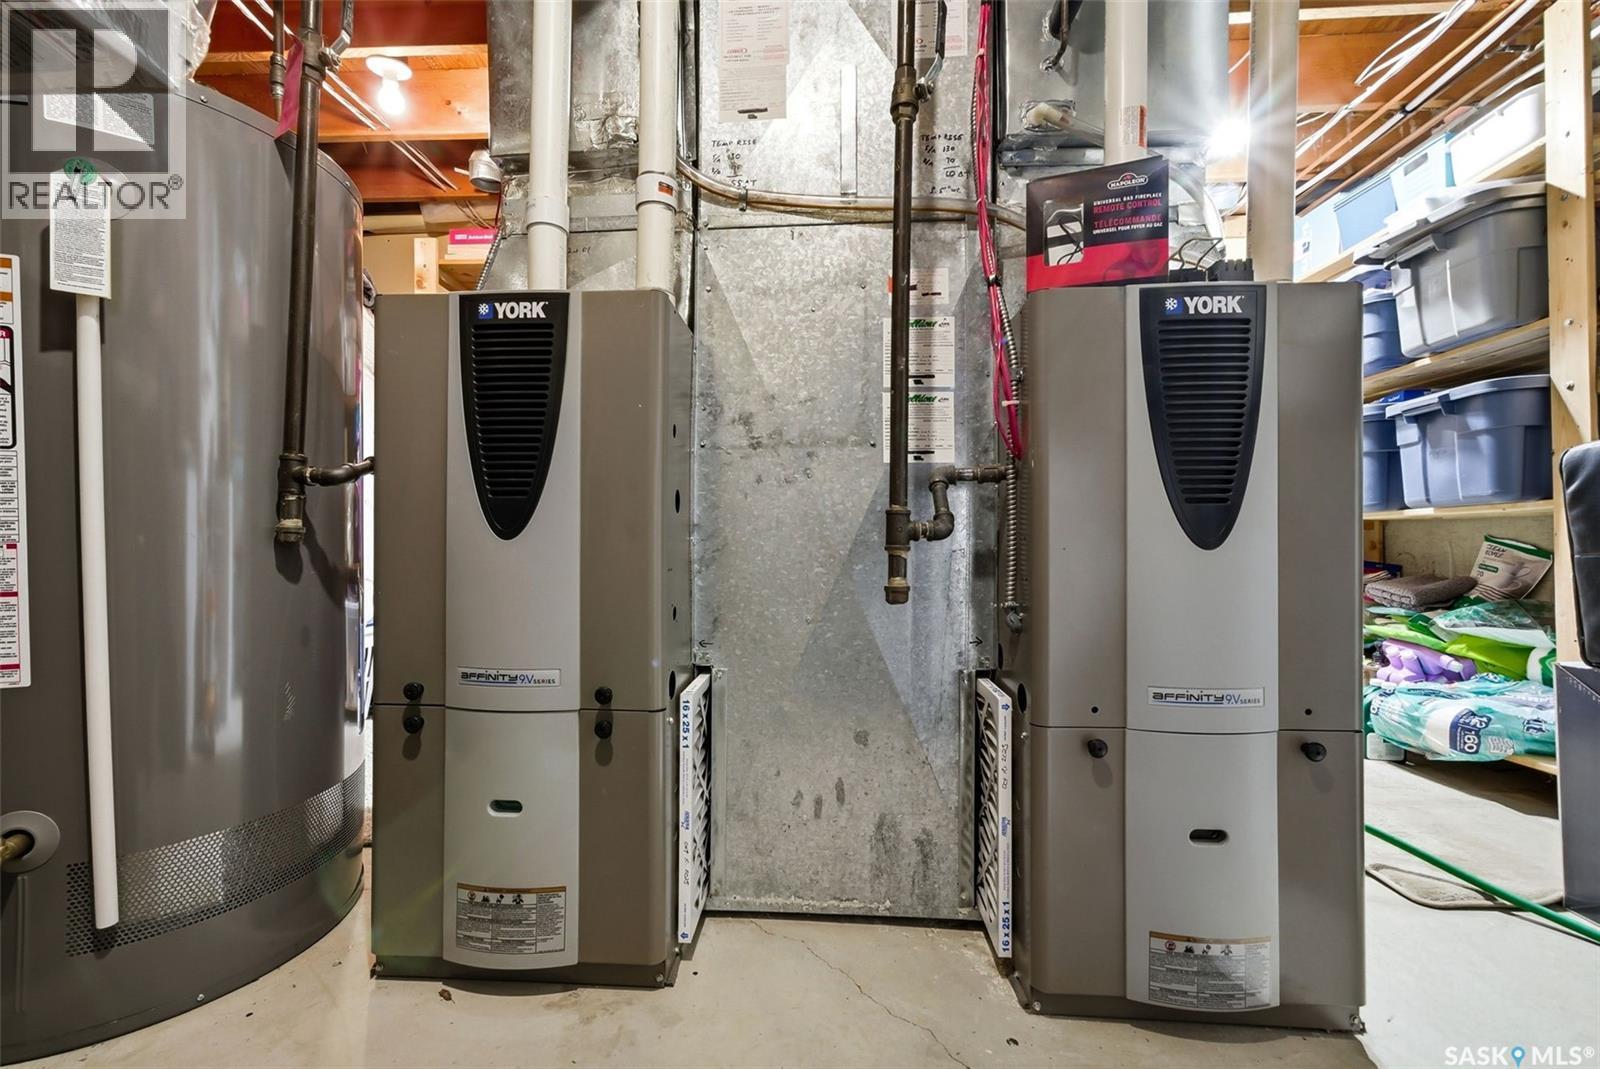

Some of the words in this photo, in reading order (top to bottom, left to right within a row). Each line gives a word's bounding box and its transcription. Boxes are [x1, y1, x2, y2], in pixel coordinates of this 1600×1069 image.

[1110, 177, 1146, 188] NAPOLEON
[1093, 197, 1121, 206] UNIVERSAL
[1093, 203, 1125, 214] REMOTE
[1126, 199, 1162, 209] CONTROL
[494, 301, 547, 319] YORK
[1183, 295, 1243, 314] YORK
[682, 699, 690, 711] 16
[682, 721, 690, 733] 25
[1002, 917, 1010, 930] 25
[1002, 940, 1010, 952] 16
